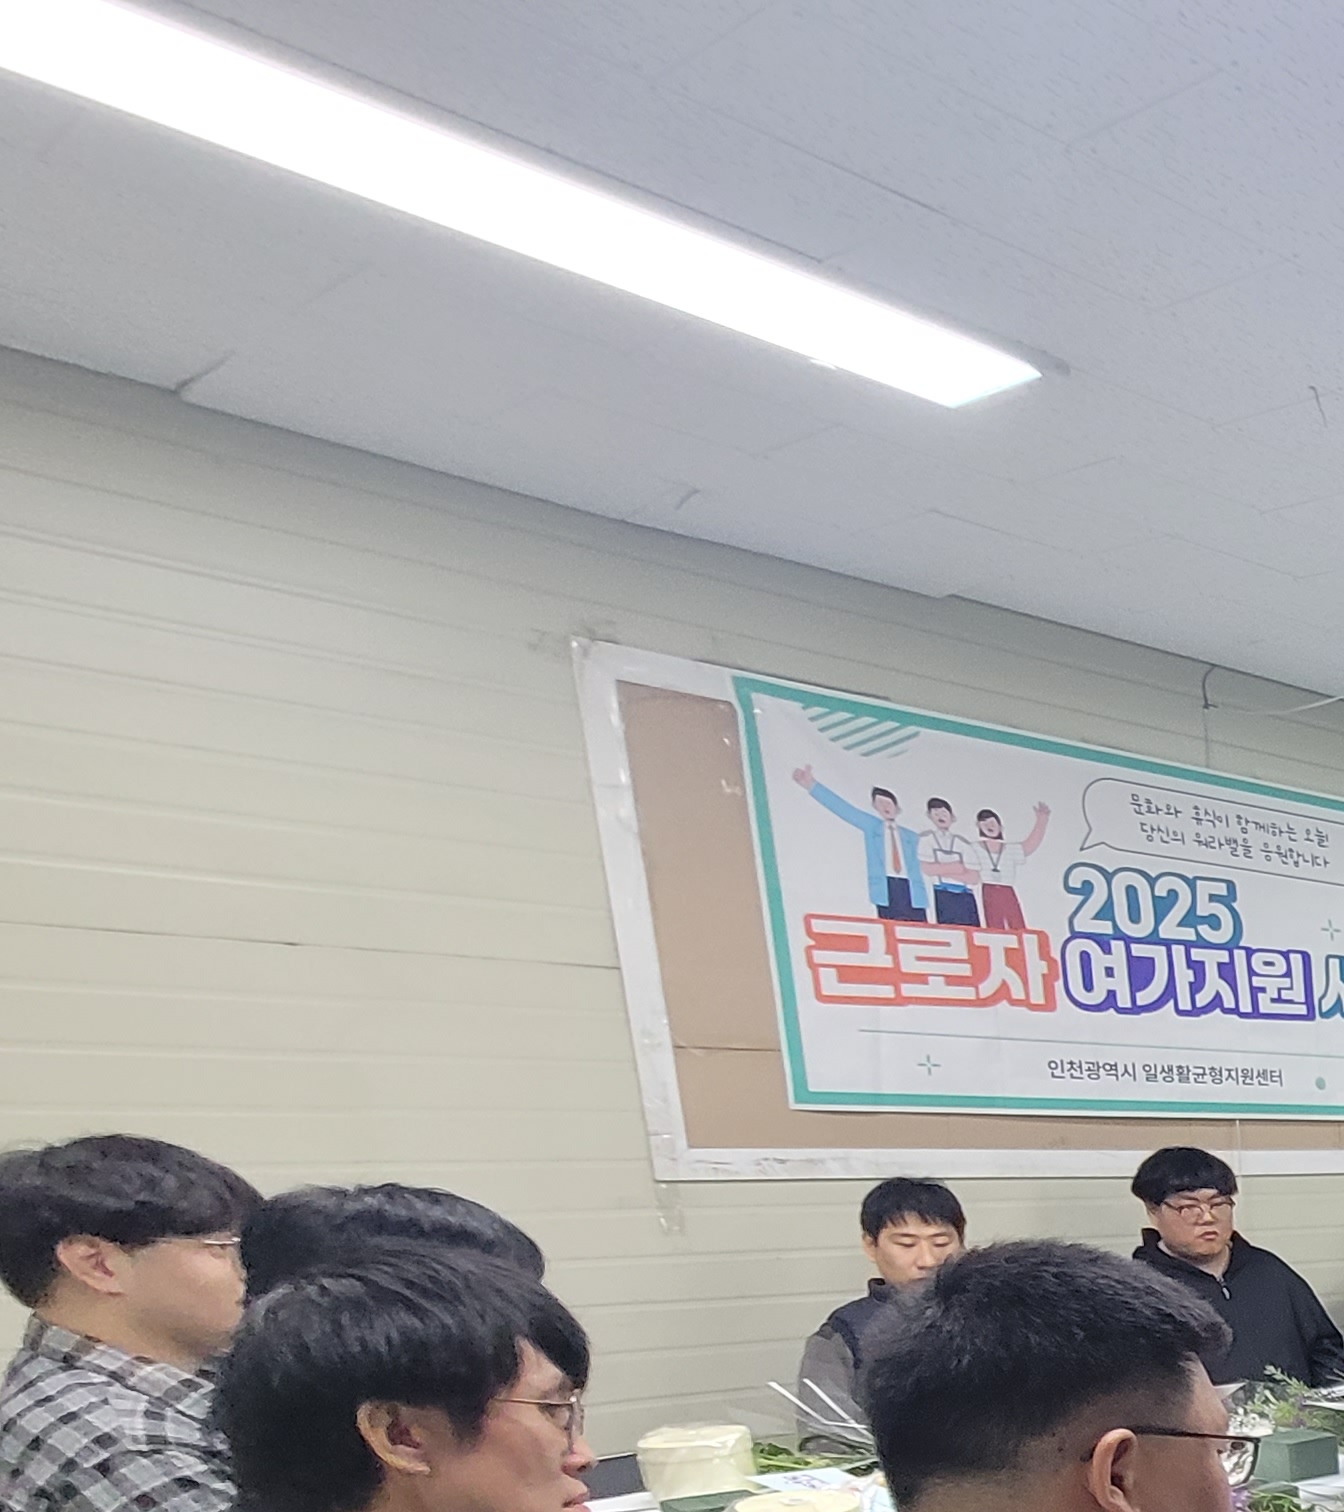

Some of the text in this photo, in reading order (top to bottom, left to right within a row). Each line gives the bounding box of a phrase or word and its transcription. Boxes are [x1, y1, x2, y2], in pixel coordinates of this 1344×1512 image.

[1129, 793, 1183, 817] 문화와
[1190, 805, 1230, 828] 휴식이
[1235, 814, 1297, 843] 함께하는
[1139, 821, 1331, 869] 당신의 워라밸을 응원합니다
[1066, 864, 1240, 944] 2025
[808, 915, 1056, 1009] 근로자
[1063, 938, 1311, 1020] 여가지원
[1047, 1058, 1284, 1088] 인천광역시 일생활균형지원센터
